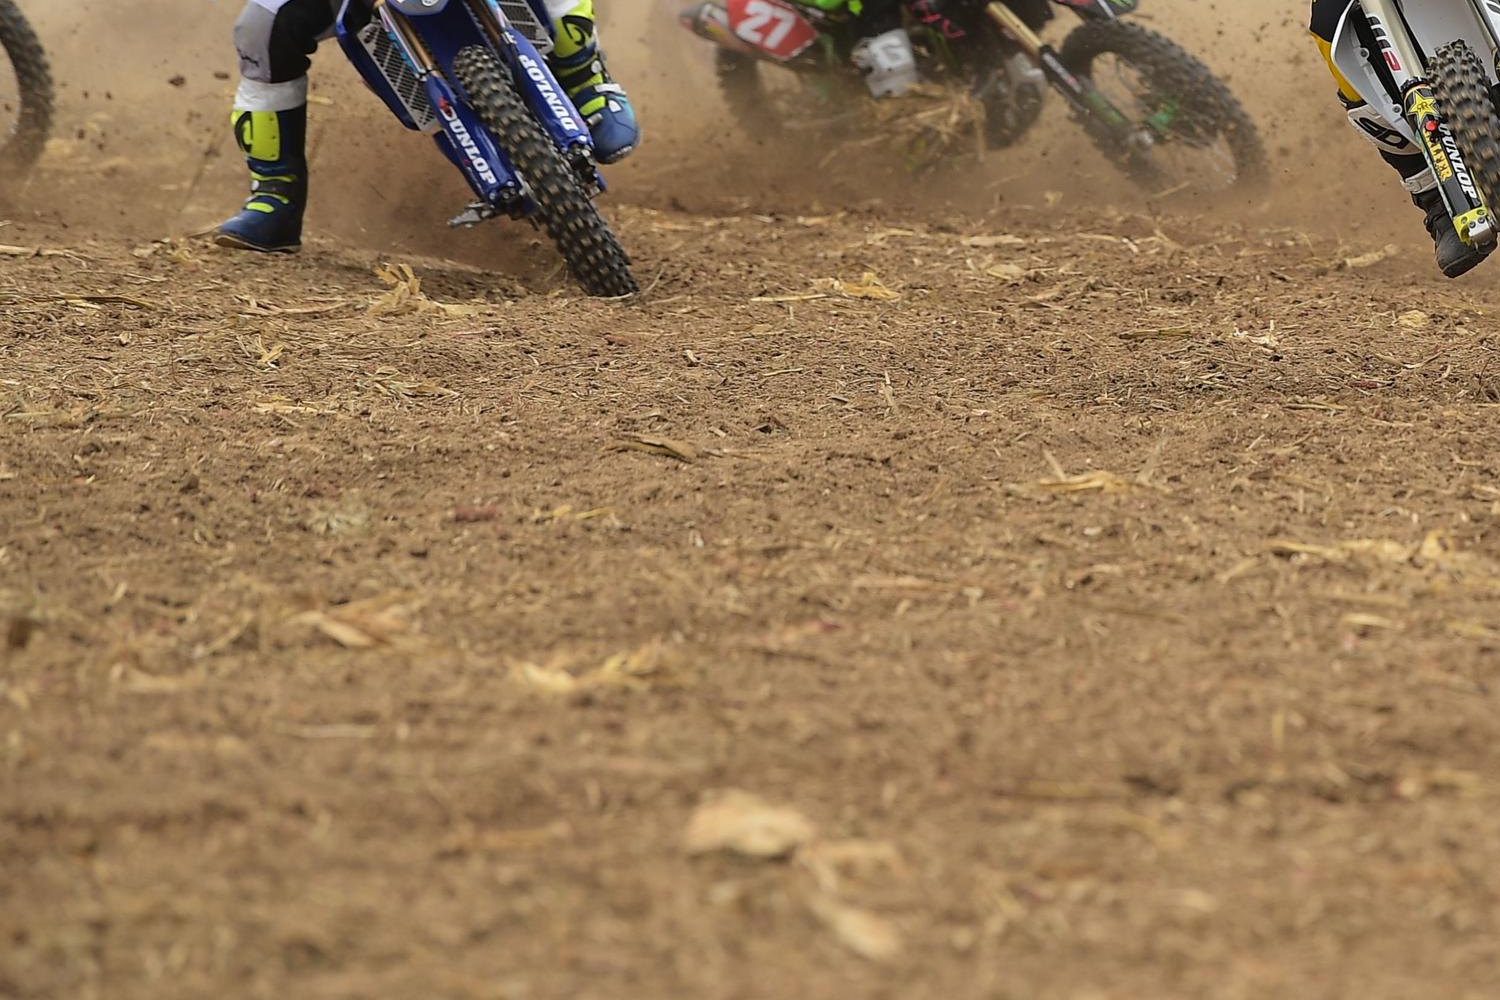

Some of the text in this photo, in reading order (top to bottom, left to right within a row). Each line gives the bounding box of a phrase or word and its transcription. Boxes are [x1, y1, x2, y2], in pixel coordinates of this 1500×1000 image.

[735, 0, 797, 50] 27
[518, 54, 580, 132] DUNLOP
[439, 105, 497, 185] DUNLOP
[1437, 122, 1478, 200] DUNLOP
